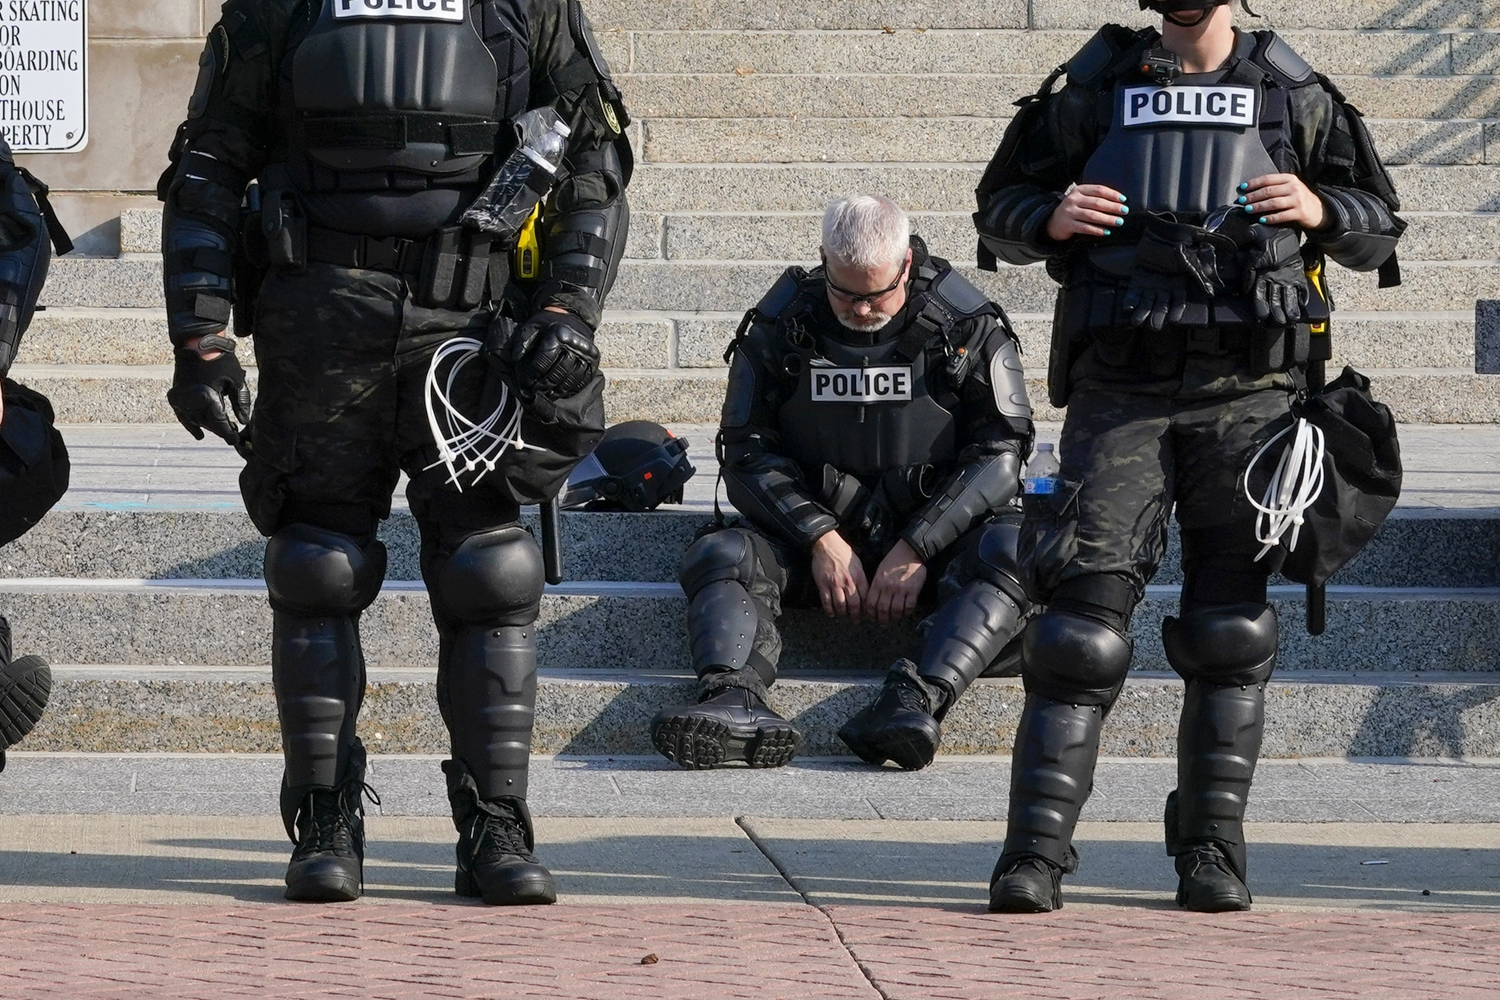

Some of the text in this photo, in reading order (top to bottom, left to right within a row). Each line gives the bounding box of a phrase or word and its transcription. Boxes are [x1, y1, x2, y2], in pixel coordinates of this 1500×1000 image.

[9, 0, 79, 22] SKATING
[0, 25, 21, 46] OR
[0, 74, 21, 96] ON
[1129, 91, 1247, 119] POLICE
[2, 124, 52, 146] PERTY
[816, 373, 907, 397] POLICE
